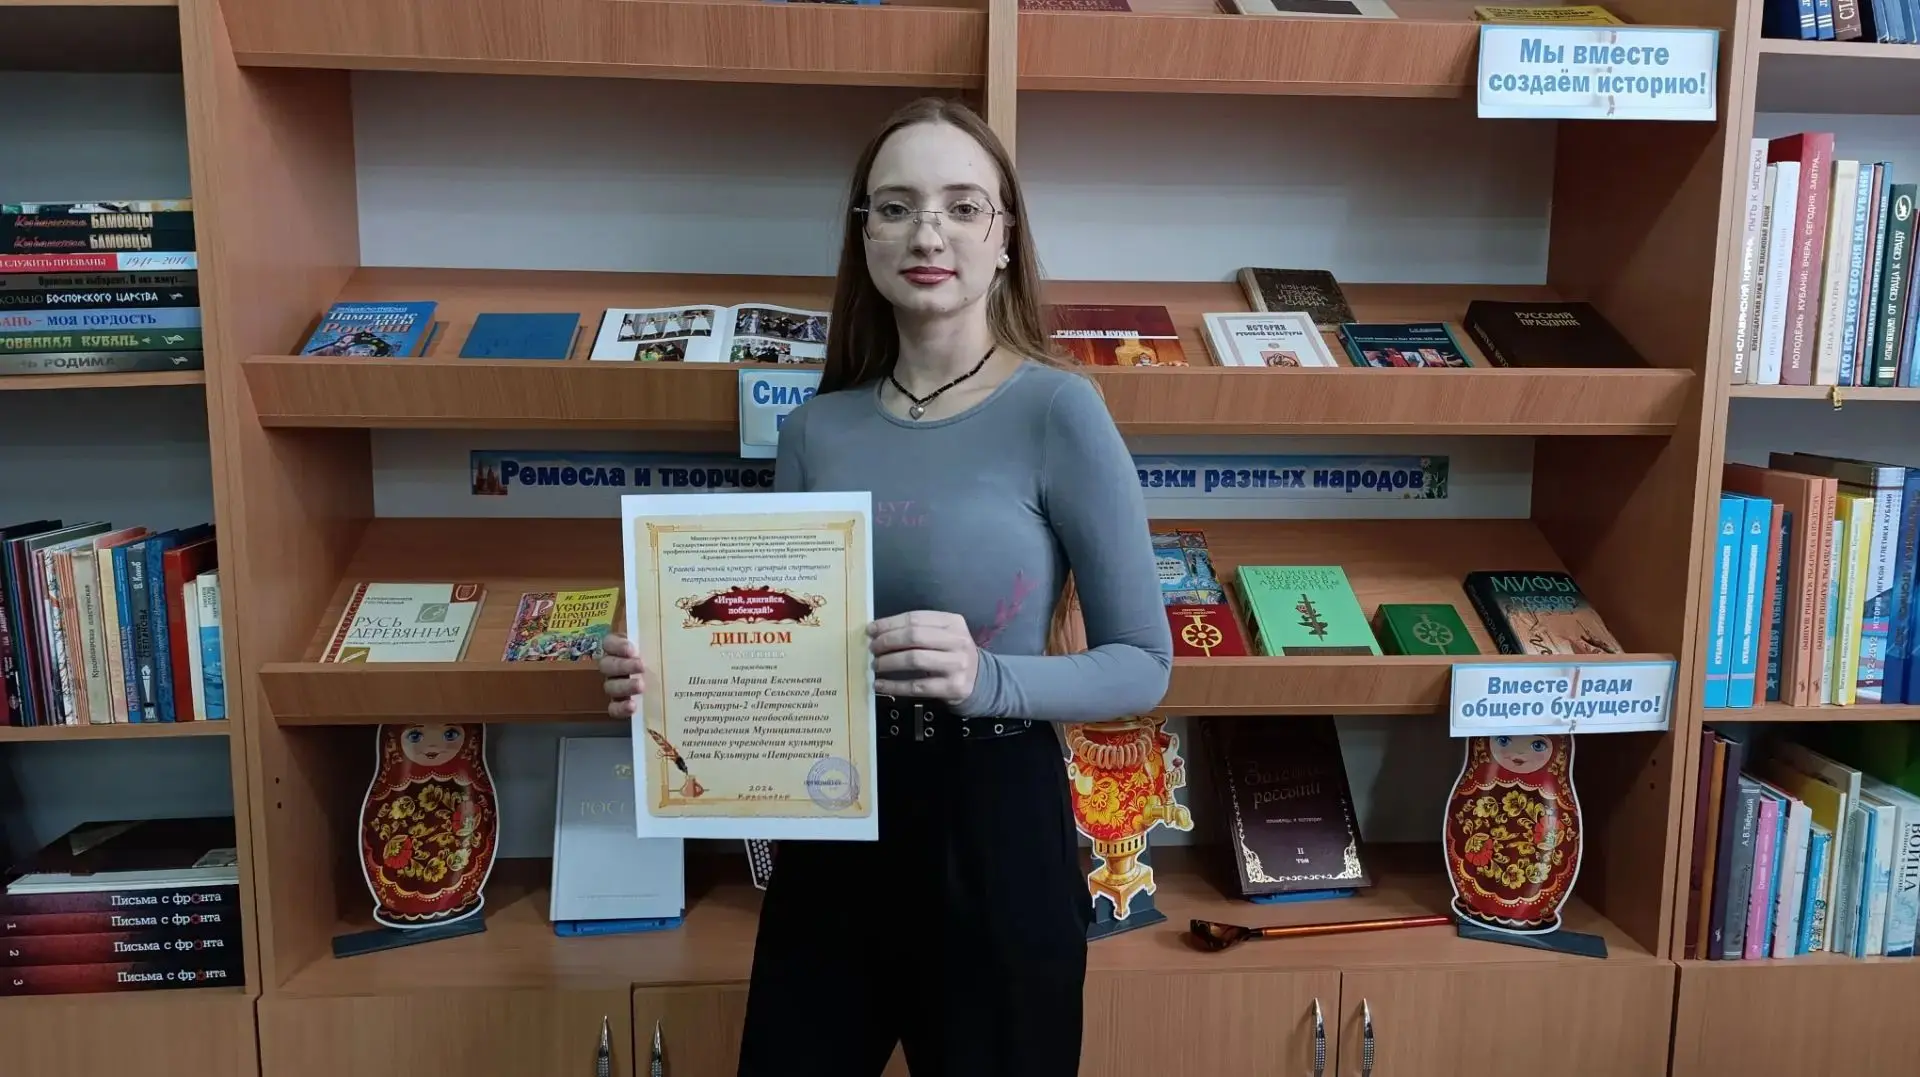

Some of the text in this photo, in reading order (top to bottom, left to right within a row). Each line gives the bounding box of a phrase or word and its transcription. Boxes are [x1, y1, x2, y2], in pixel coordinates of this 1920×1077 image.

[1519, 38, 1669, 66] Мы вместе
[1488, 69, 1707, 98] создаём историю!
[1751, 149, 1763, 190] УСПЕХУ
[1748, 204, 1758, 231] ПУТЬ
[1805, 192, 1818, 235] СЕГОДНЯ,
[90, 213, 153, 229] БАМОВЦЫ
[90, 233, 152, 250] БАМОВЦЫ
[1892, 230, 1905, 260] СЕРДЦУ
[1802, 238, 1813, 267] ВЧЕРА,
[3, 258, 106, 268] СЛУЖИТЬ ПРИЗВАНЫ
[1840, 171, 1870, 378] КТО ЕСТЬ КТО СЕГОДНЯ НА КУБАНИ
[1797, 270, 1808, 310] КУБАНИ:
[1888, 271, 1901, 301] СЕРДЦА
[46, 291, 158, 304] БОСПОРСКОГО ЦАРСТВА
[1514, 311, 1576, 319] РУССКИЙ
[1887, 303, 1897, 315] ОТ
[47, 315, 78, 326] МОЯ
[82, 313, 157, 326] ГОРДОСТЬ
[1519, 318, 1582, 327] ПРАЗДНИК
[321, 322, 412, 334] России
[1055, 329, 1139, 337] РУССКАЯ КУХНЯ
[81, 334, 139, 348] КУБАНЬ
[1792, 314, 1804, 369] МОЛОДЁЖЬ
[500, 460, 775, 488] Ремесла и творчес
[1136, 468, 1424, 493] азки разных народов
[1490, 576, 1577, 593] МИФЫ
[1865, 493, 1893, 686] 1912-2012 ИСТОРИЯ ЛЕГКОЙ АТЛЕТИКИ КУБАНИ
[714, 595, 785, 605] «Играй, двигайся,
[1510, 595, 1576, 604] РУССКОГО
[553, 609, 608, 620] НАРОДНЫЕ
[728, 606, 774, 615] побеждай!»
[354, 616, 402, 628] РУСЬ
[550, 618, 590, 629] ИГРЫ
[84, 584, 100, 678] Краснодарская пластунская
[349, 626, 461, 639] ДЕРЕВЯННАЯ
[710, 631, 792, 646] ДИПЛОМ
[1769, 629, 1780, 657] СЛАВУ
[688, 676, 822, 686] Шилина Марина Евгеньевна
[1487, 676, 1633, 696] Вместе ради
[674, 688, 837, 698] культорганизатор Сельского Дома
[693, 700, 819, 710] Культуры-2 «Петровский»
[1461, 696, 1661, 718] общего будущего!
[684, 713, 830, 723] структурного необособленного
[683, 726, 832, 736] подразделения Муниципального
[682, 738, 833, 749] казенного учреждения культуры
[686, 751, 711, 760] Дома
[713, 751, 760, 760] Культуры
[1904, 823, 1920, 892] ВОЙНА
[111, 894, 158, 906] Письма
[172, 891, 221, 905] фронта
[111, 915, 158, 927] Письма
[172, 912, 221, 926] фронта
[6, 923, 17, 931] 1
[114, 941, 160, 953] Письма
[175, 938, 224, 952] фронта
[9, 949, 19, 958] 2
[117, 971, 163, 982] Письма
[178, 968, 226, 982] фронта
[13, 978, 24, 987] 3
